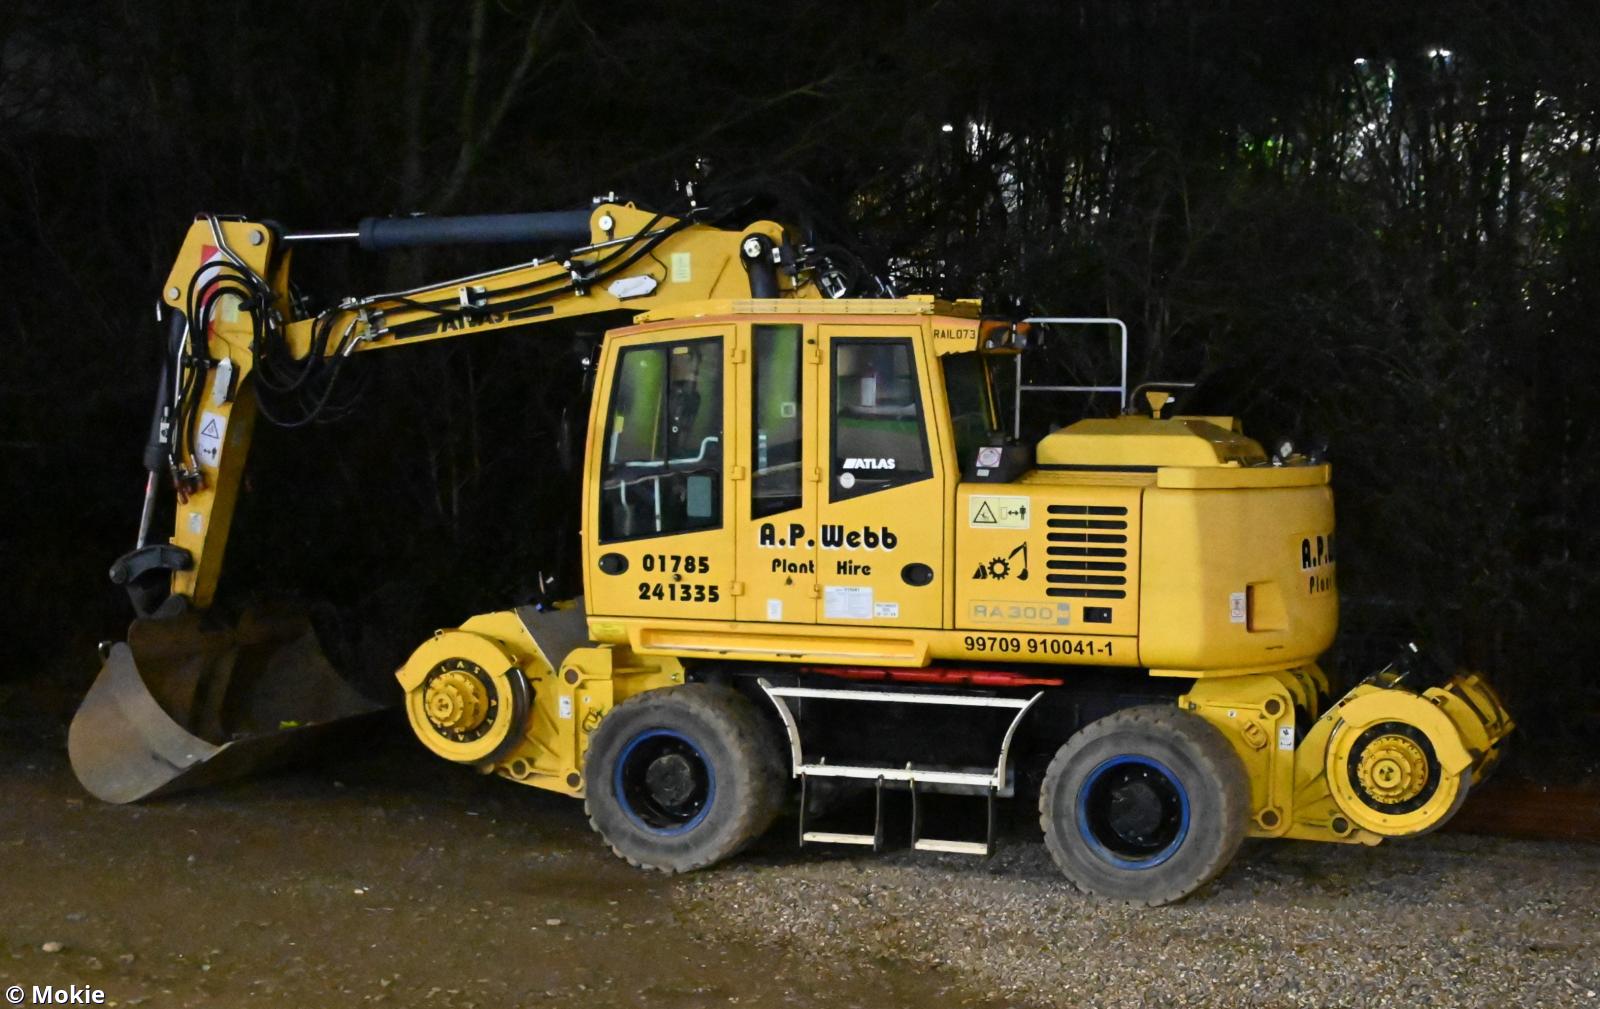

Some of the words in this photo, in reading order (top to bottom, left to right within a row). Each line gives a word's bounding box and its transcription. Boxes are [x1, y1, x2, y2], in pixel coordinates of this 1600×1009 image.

[933, 328, 976, 340] RAIL073
[854, 457, 896, 470] ATLAS
[642, 553, 710, 574] 01785
[772, 558, 815, 574] Plant
[836, 560, 872, 576] Hire
[638, 582, 720, 603] 241335
[964, 635, 1021, 653] 99709
[1027, 638, 1114, 657] 910041-1
